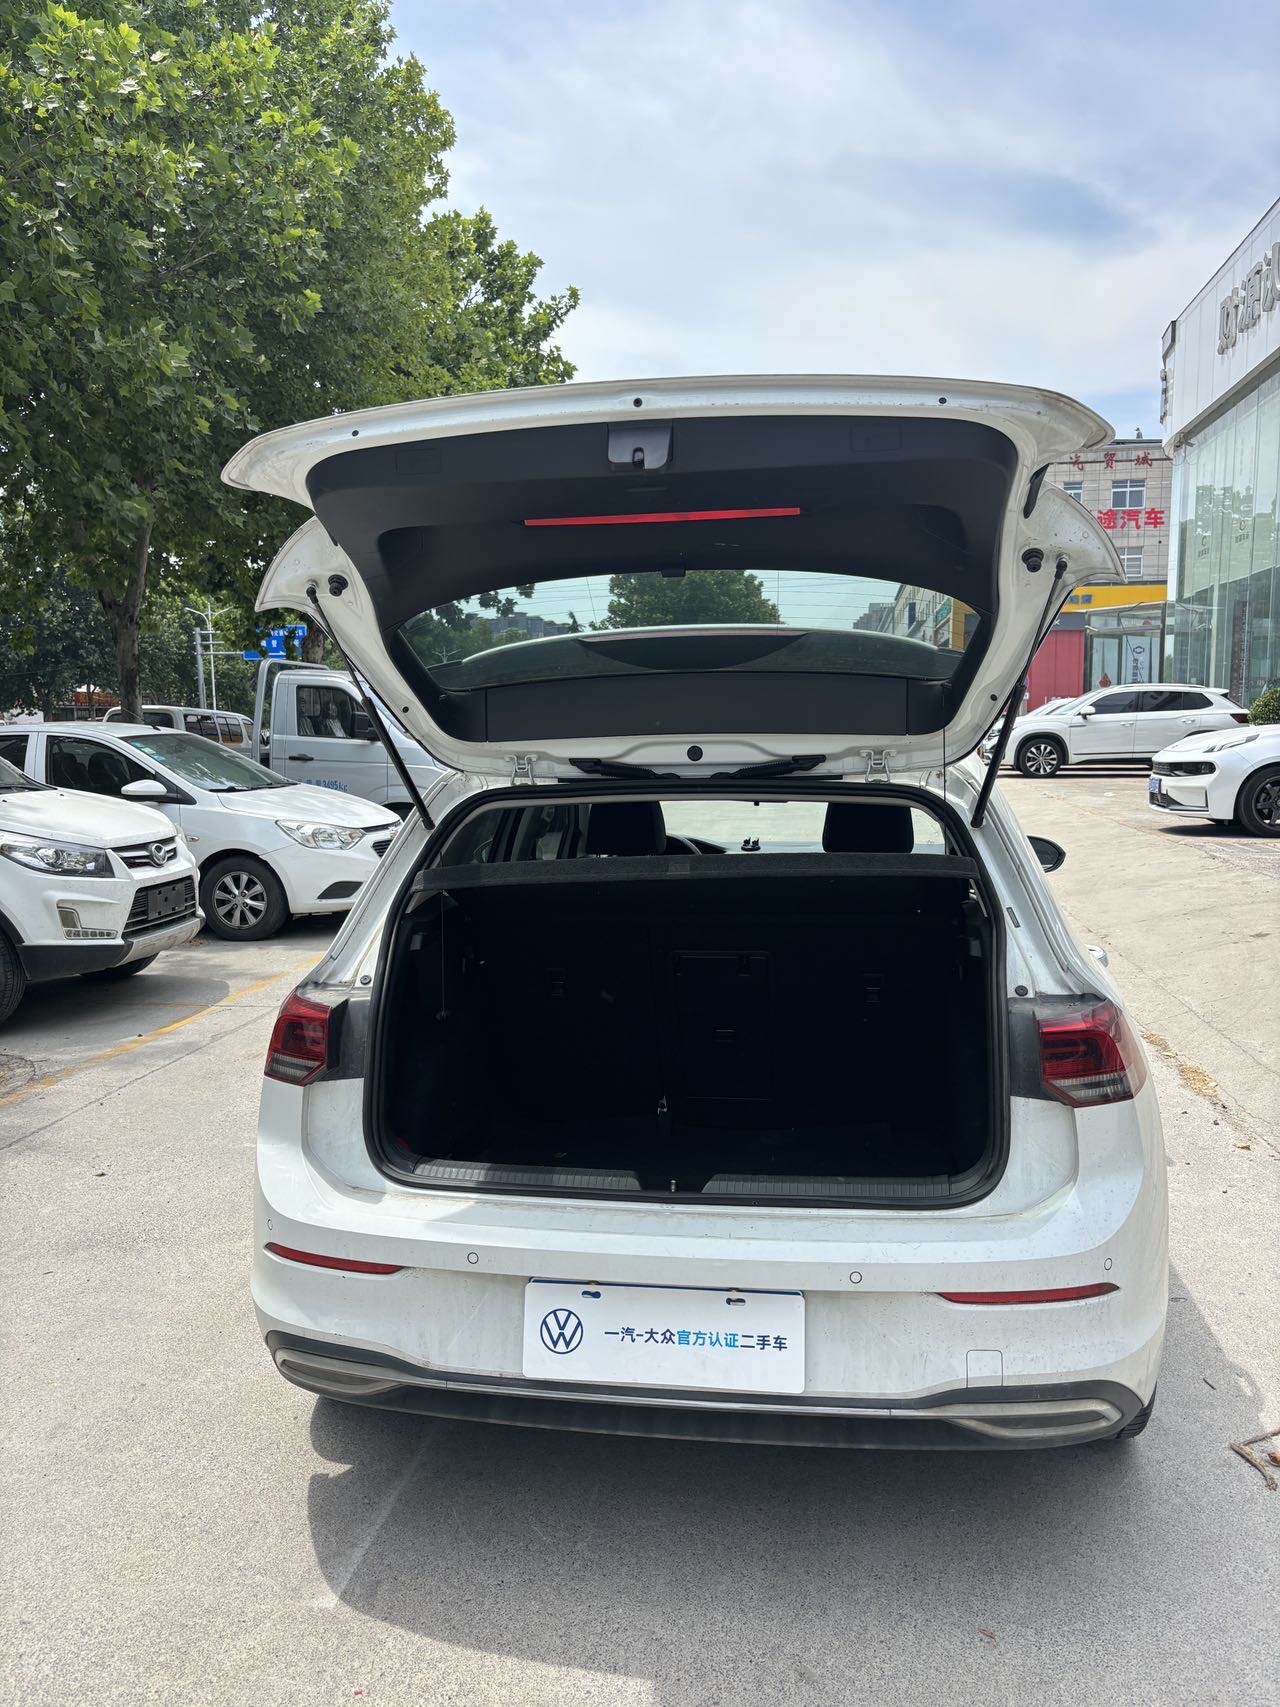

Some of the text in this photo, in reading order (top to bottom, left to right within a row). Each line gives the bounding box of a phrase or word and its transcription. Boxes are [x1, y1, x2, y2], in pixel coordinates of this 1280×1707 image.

[604, 1326, 788, 1351] 一汽-大众官方认证二手车
